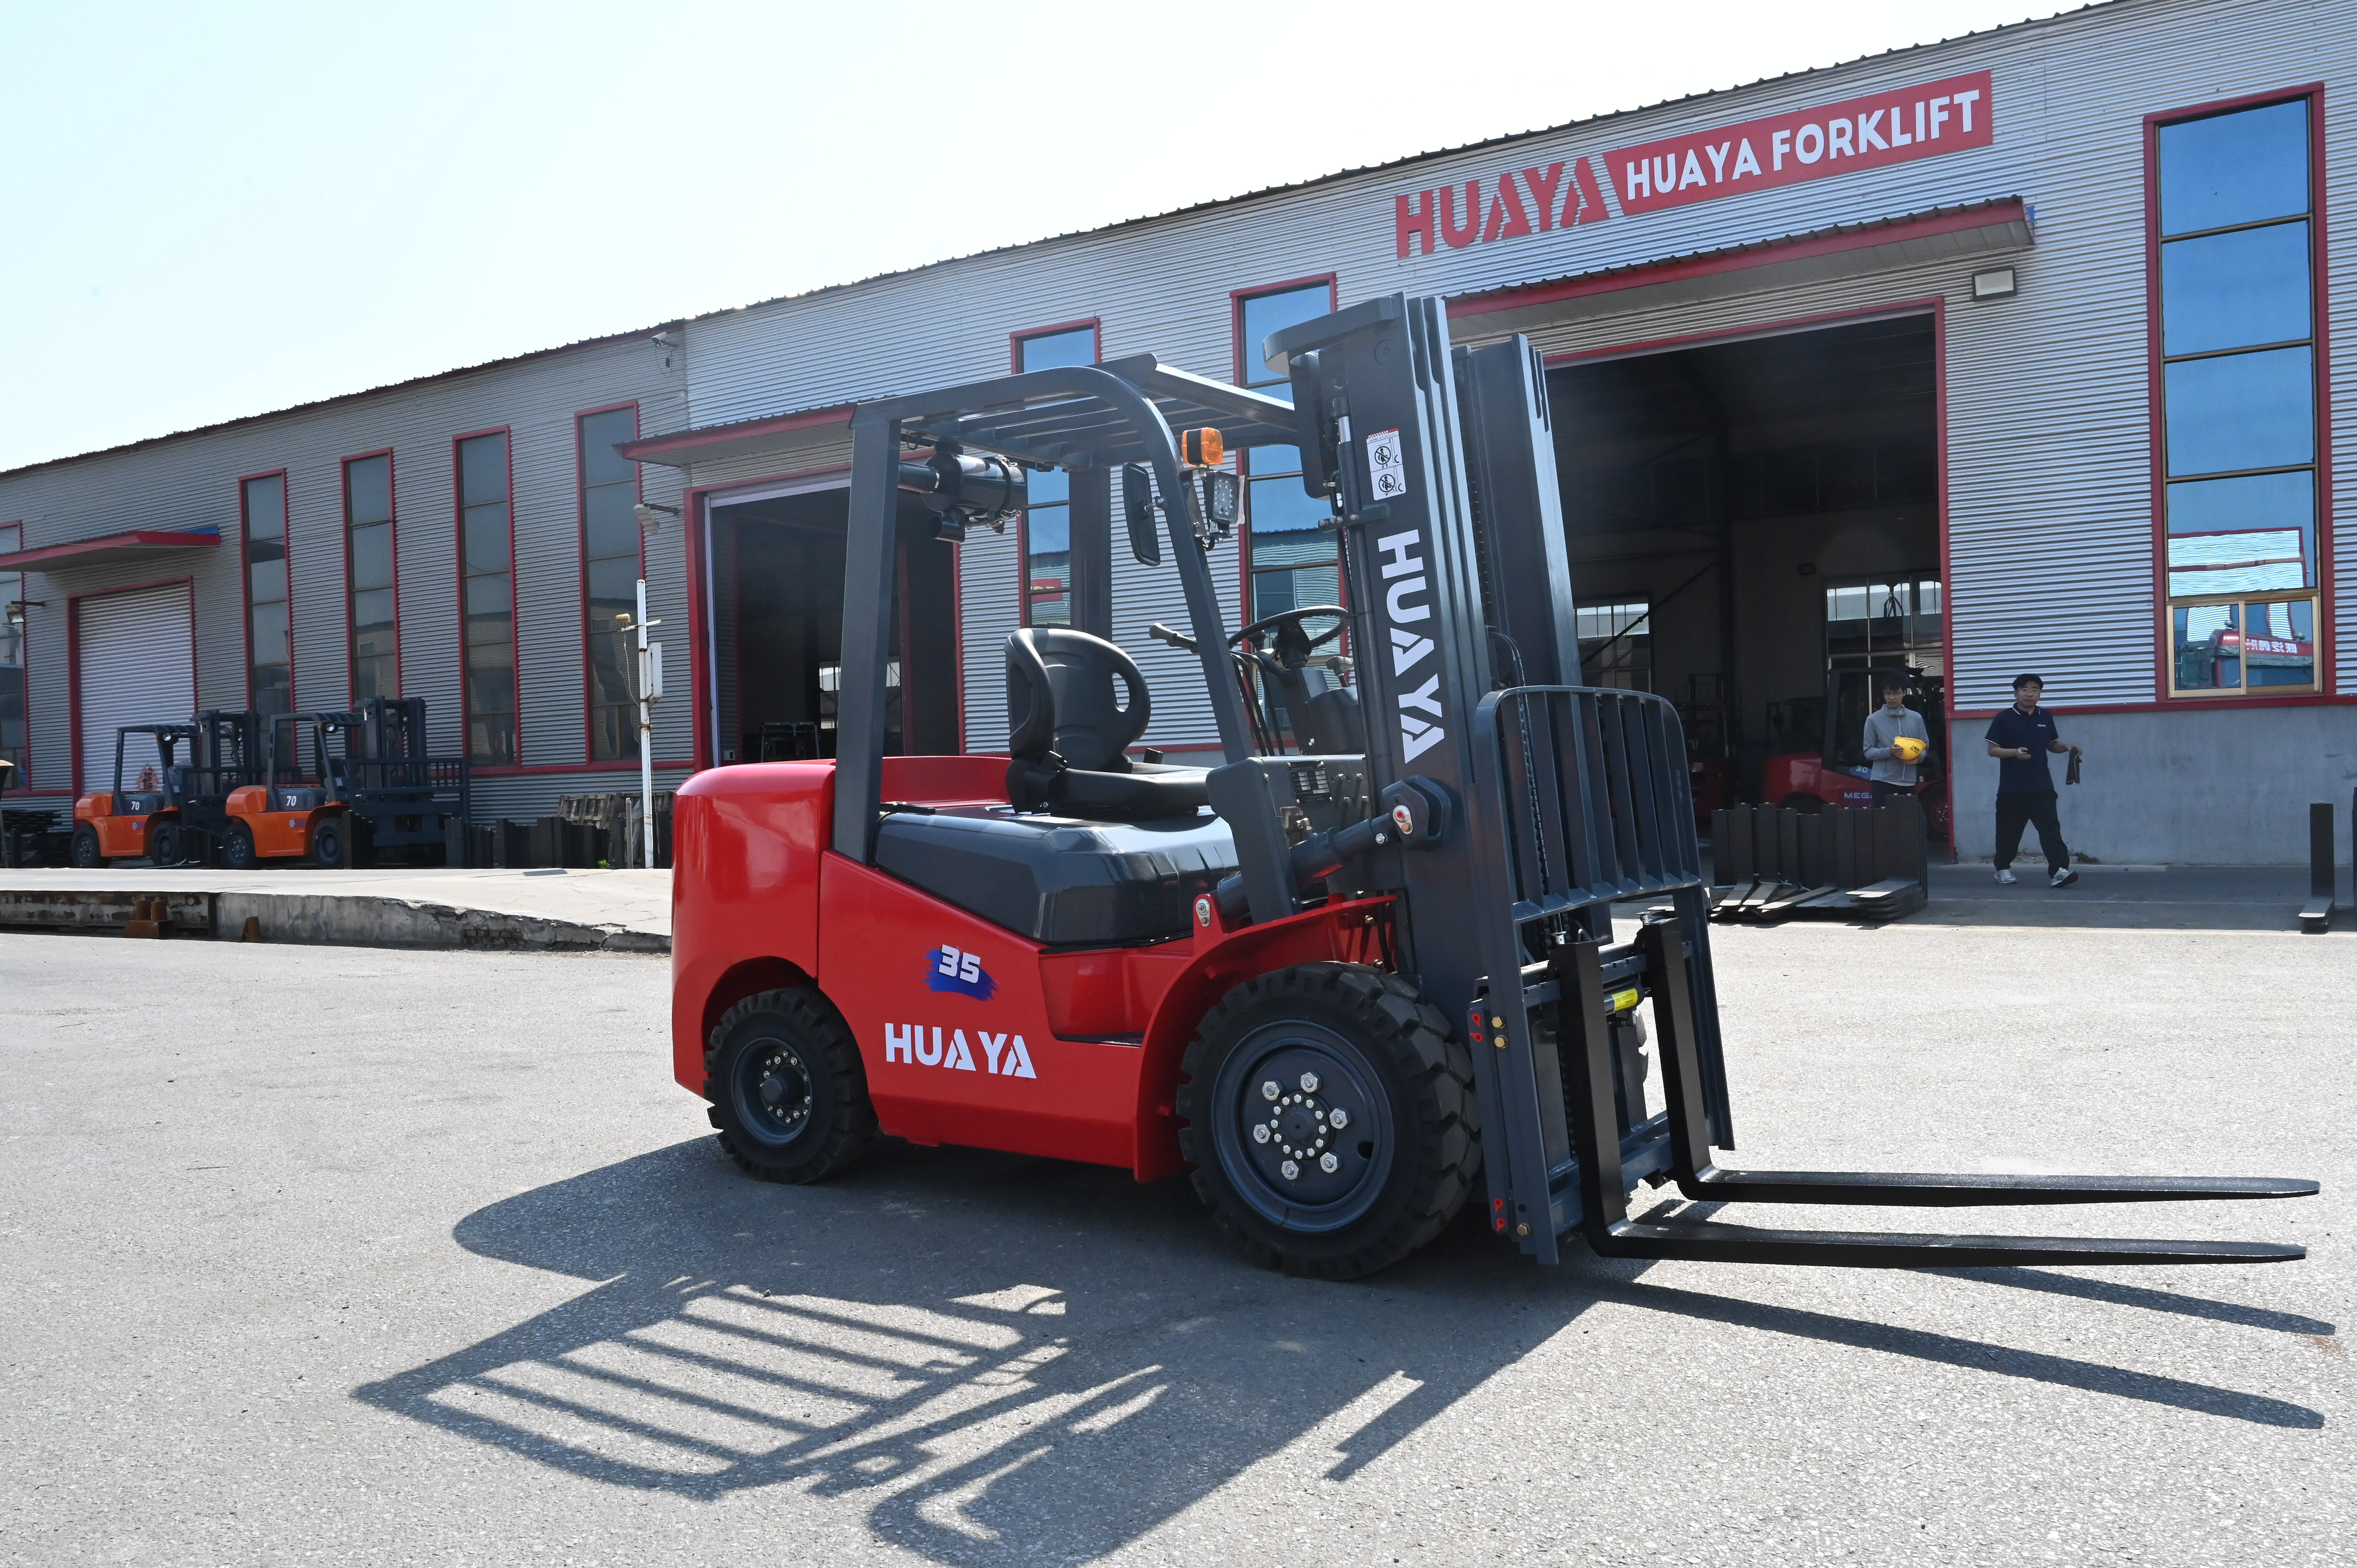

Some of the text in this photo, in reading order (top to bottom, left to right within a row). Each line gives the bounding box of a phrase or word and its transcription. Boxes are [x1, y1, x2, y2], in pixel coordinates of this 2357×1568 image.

[1627, 89, 1980, 200] HUAYA FORKLIFT
[1396, 156, 1609, 259] HUAYA
[1378, 529, 1445, 763] HUAYA
[131, 801, 140, 810] 70
[286, 795, 297, 806] 70
[939, 944, 981, 983] 35
[885, 1023, 1037, 1079] HUAYA
